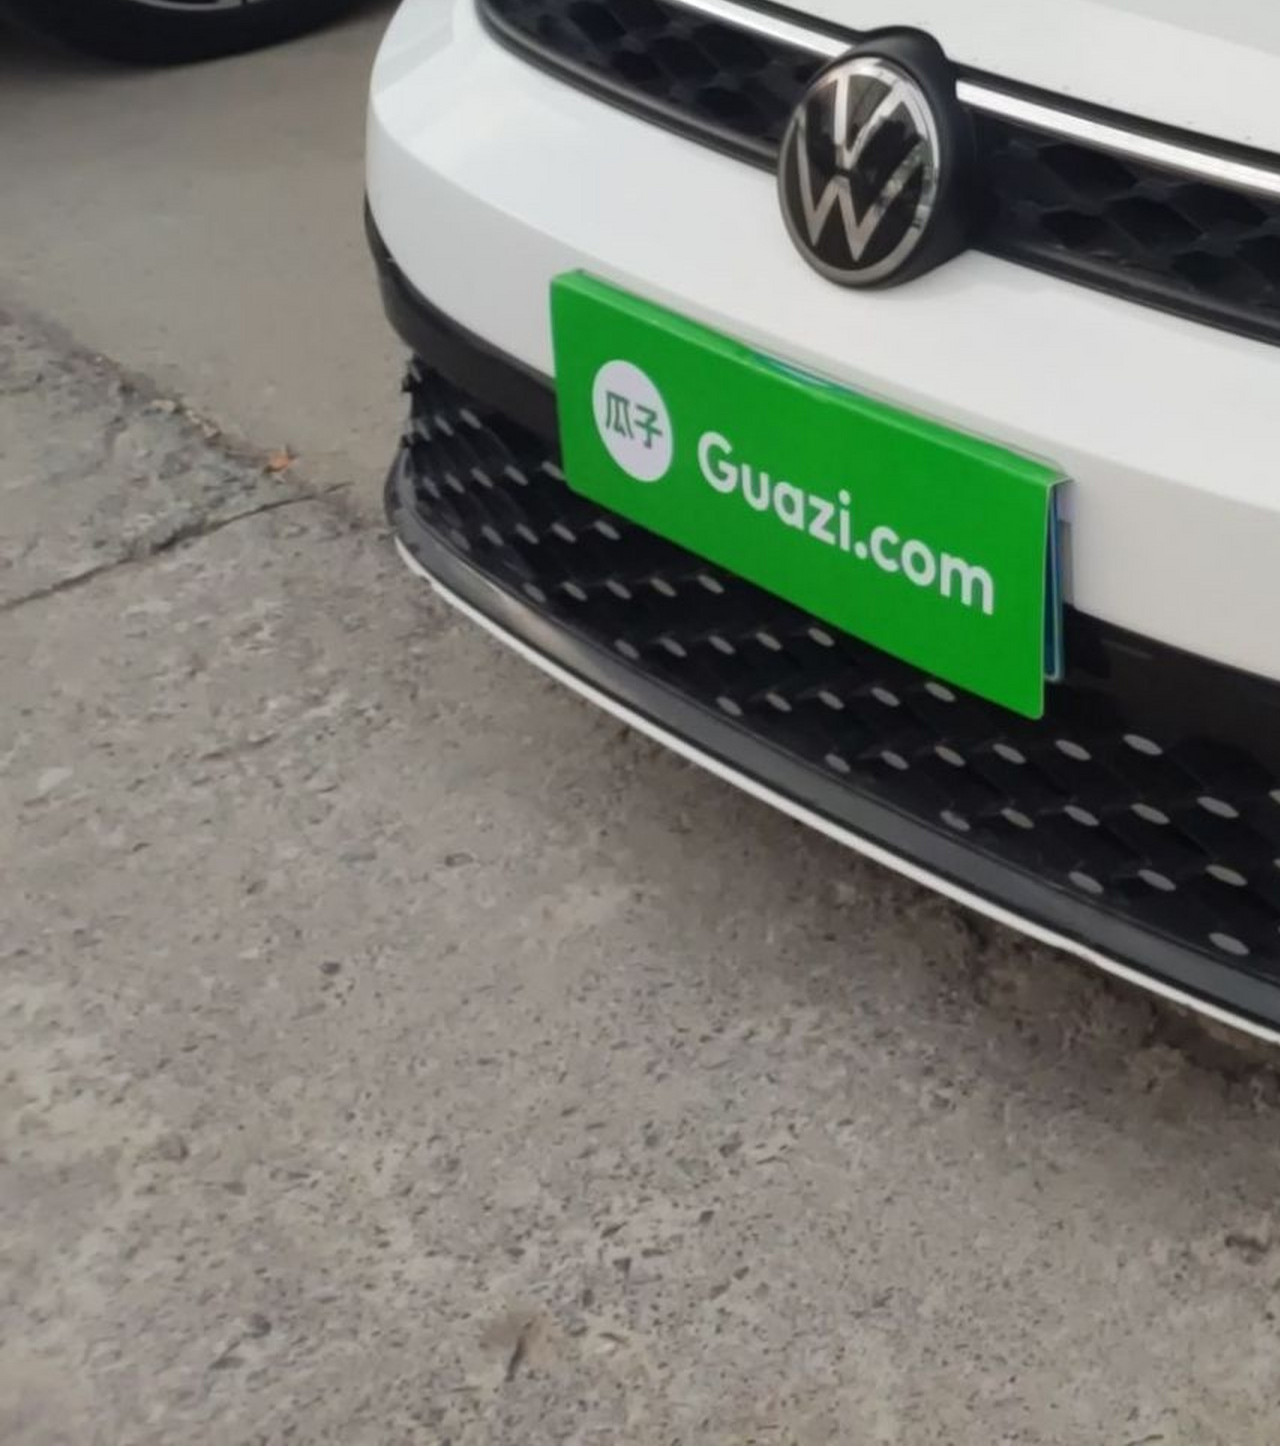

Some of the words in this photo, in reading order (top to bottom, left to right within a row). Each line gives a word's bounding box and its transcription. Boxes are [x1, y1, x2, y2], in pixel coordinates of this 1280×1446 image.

[790, 64, 933, 269] VW
[606, 391, 662, 449] 瓜子
[698, 431, 994, 616] Guazi.com
